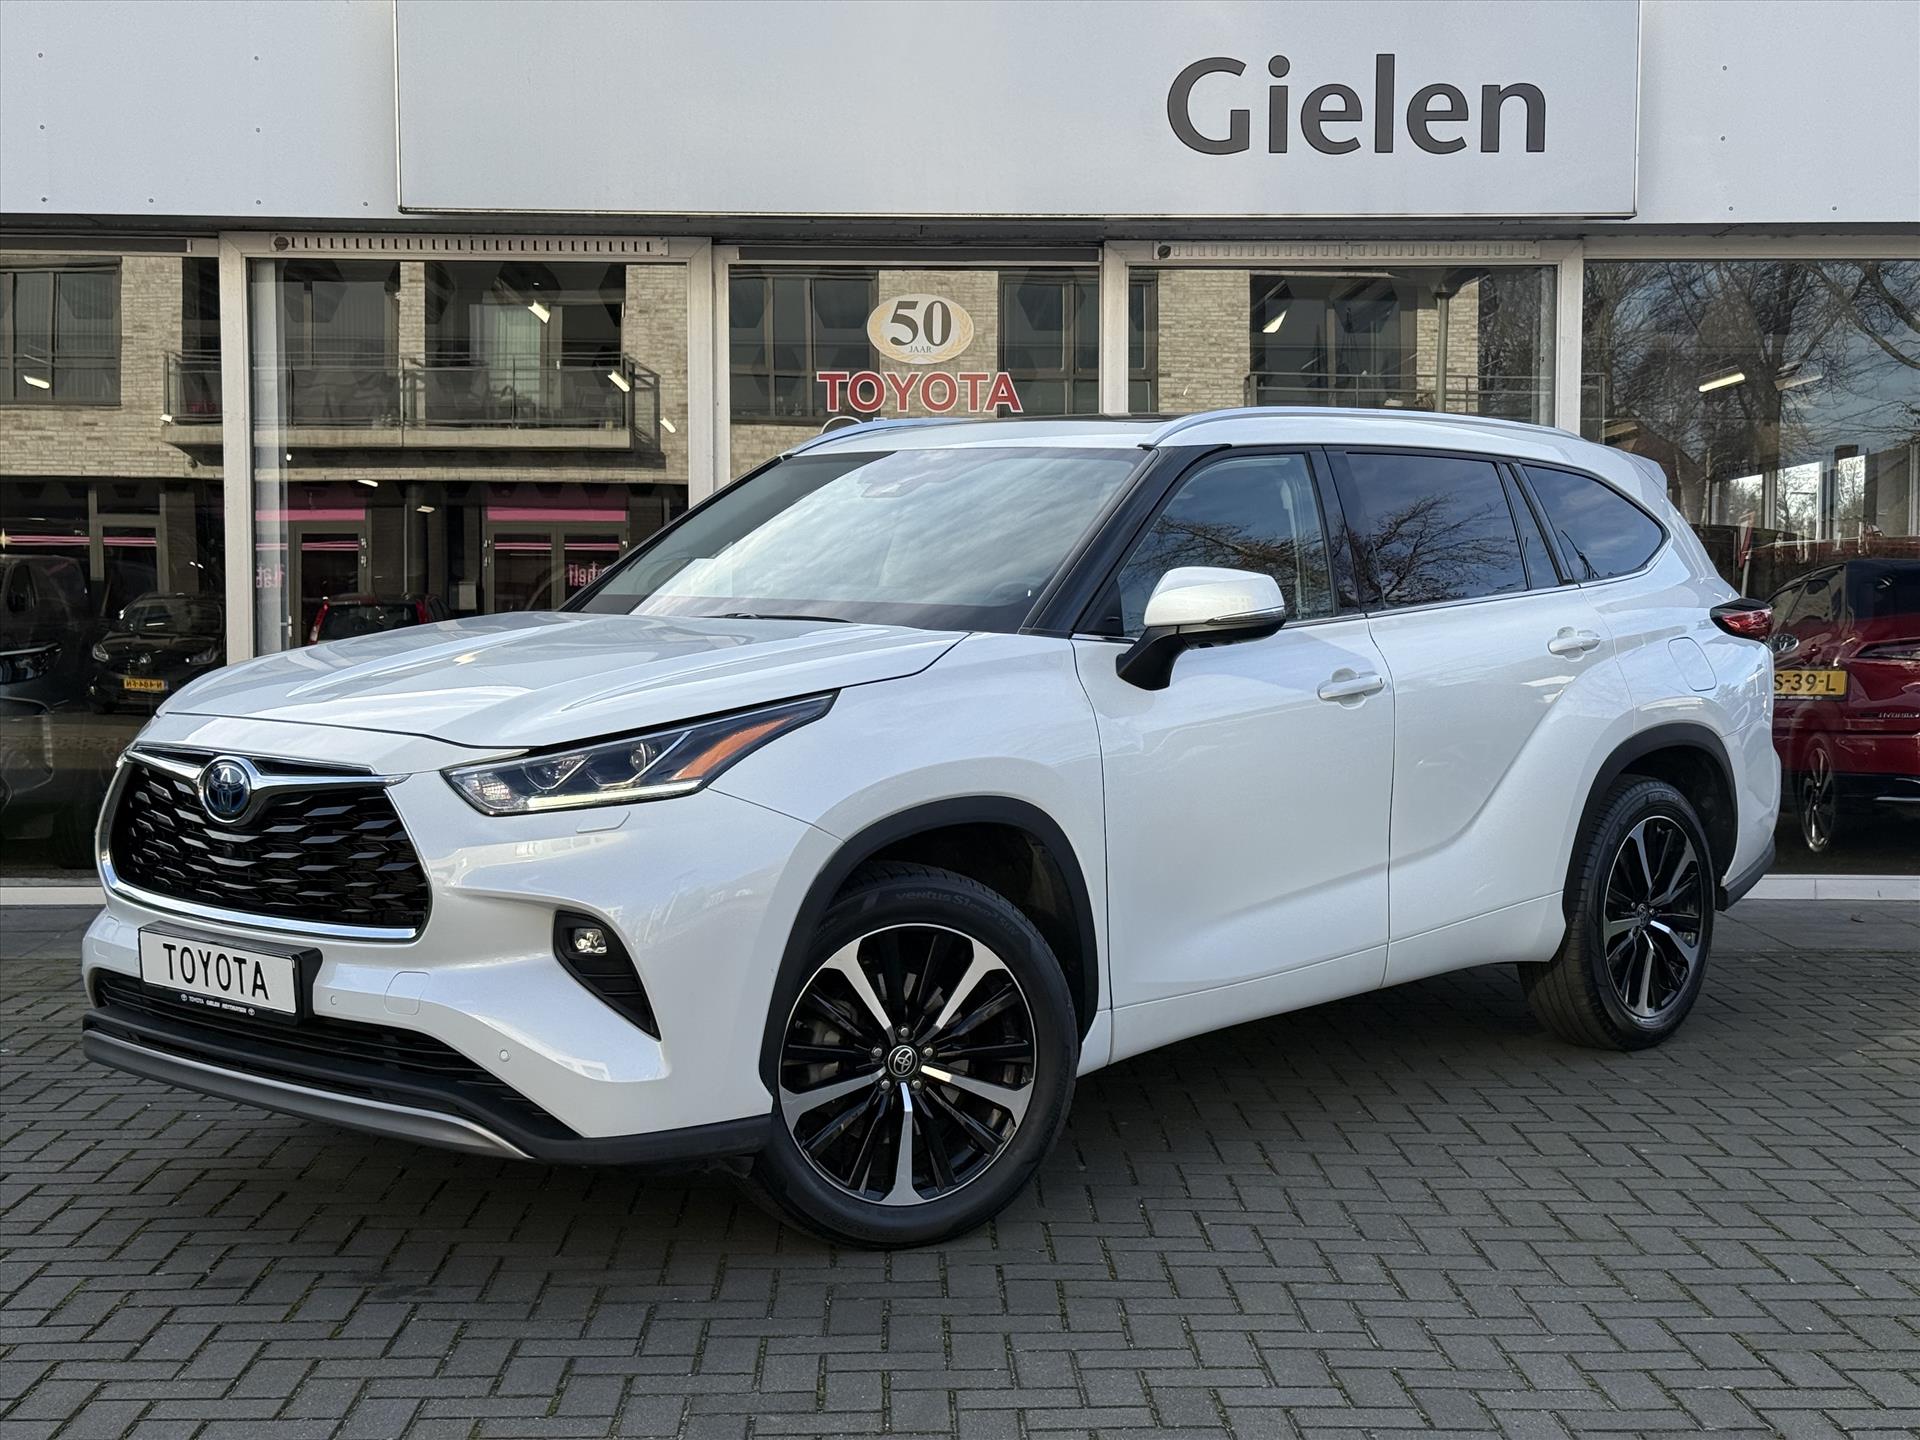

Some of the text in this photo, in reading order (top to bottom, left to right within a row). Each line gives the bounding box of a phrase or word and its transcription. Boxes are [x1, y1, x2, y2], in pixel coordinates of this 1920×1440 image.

[1167, 53, 1546, 155] Gielen
[889, 300, 952, 347] 50
[909, 345, 932, 353] JAAR
[816, 371, 1023, 413] TOYOTA
[163, 943, 270, 1000] TOYOTA
